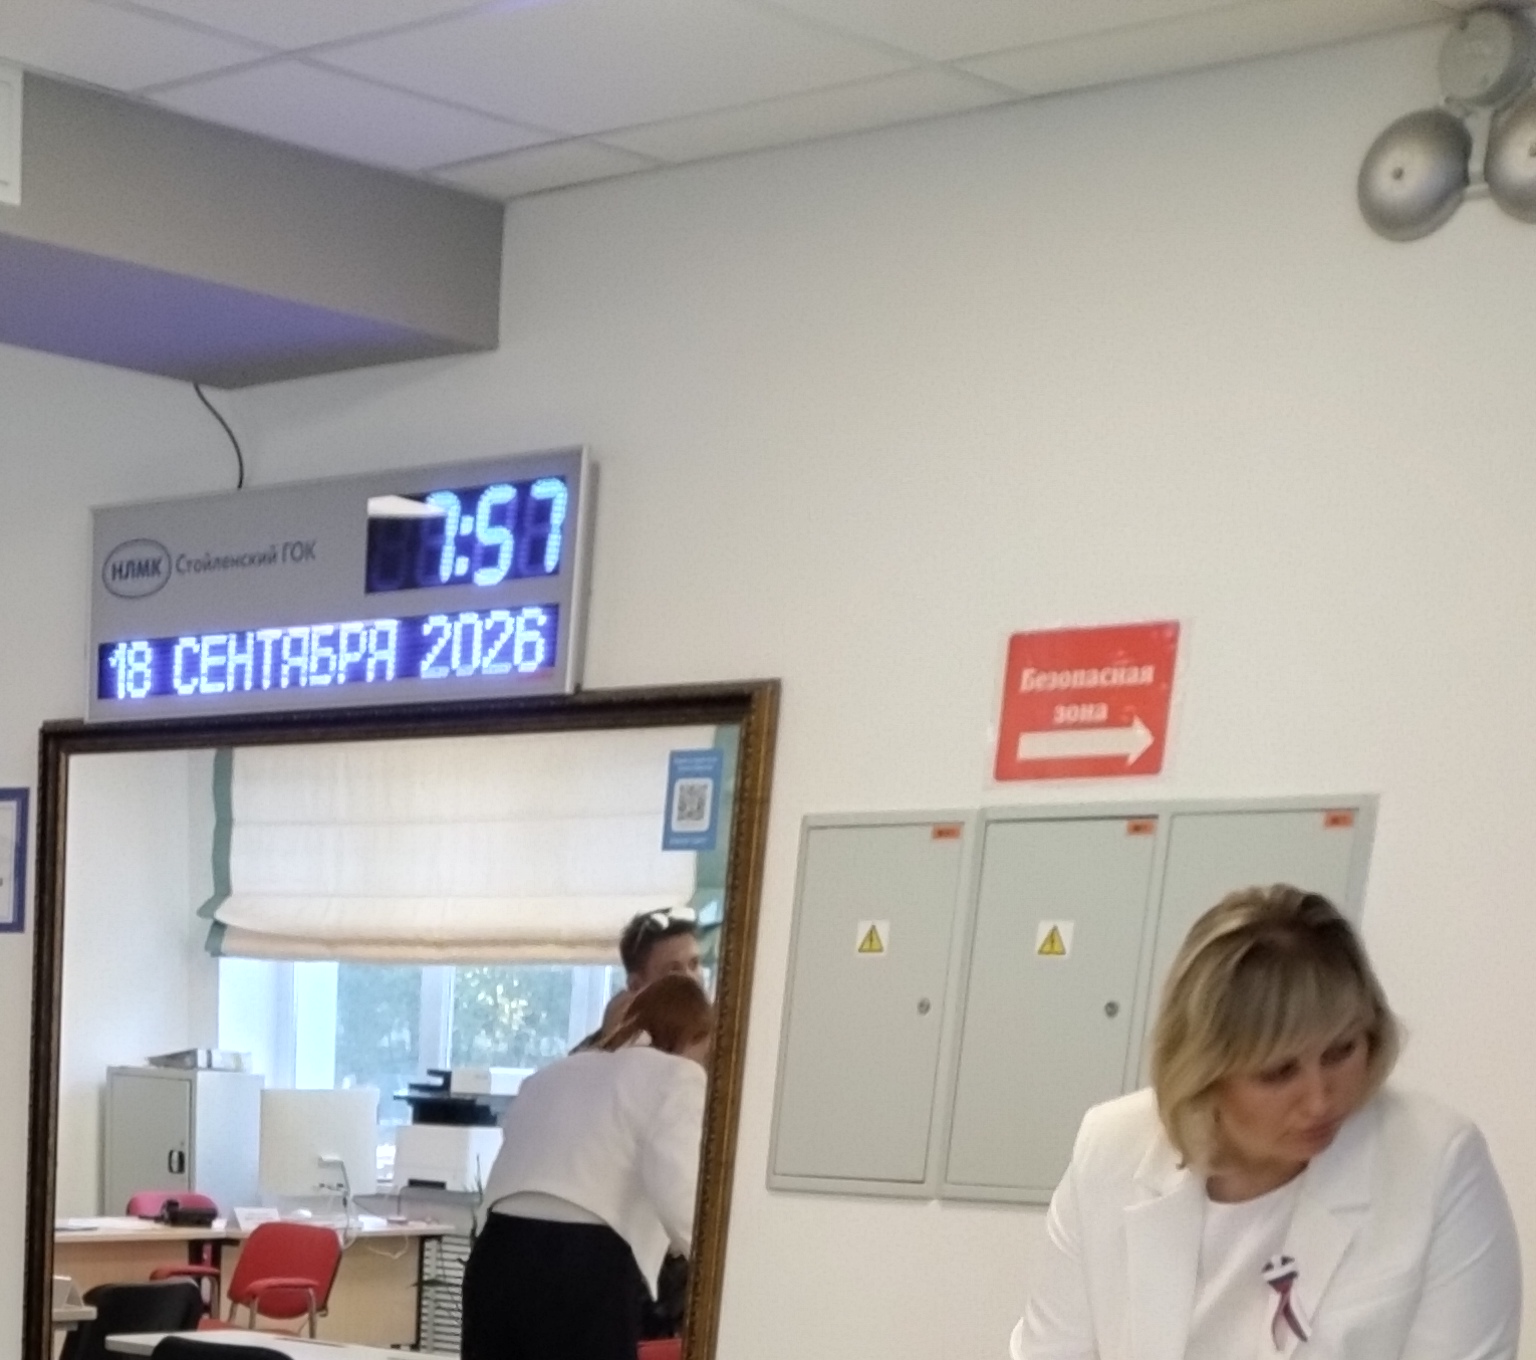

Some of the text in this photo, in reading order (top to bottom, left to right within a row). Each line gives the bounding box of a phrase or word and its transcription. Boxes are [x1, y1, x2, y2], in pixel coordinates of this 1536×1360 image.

[425, 477, 568, 586] 7:57
[111, 558, 162, 581] НЛМК
[175, 540, 316, 575] Стойленский ГОК
[108, 606, 547, 699] 18 СЕНТЯБРЯ 2026
[1019, 664, 1155, 694] Безопасная
[1052, 702, 1109, 724] зона
